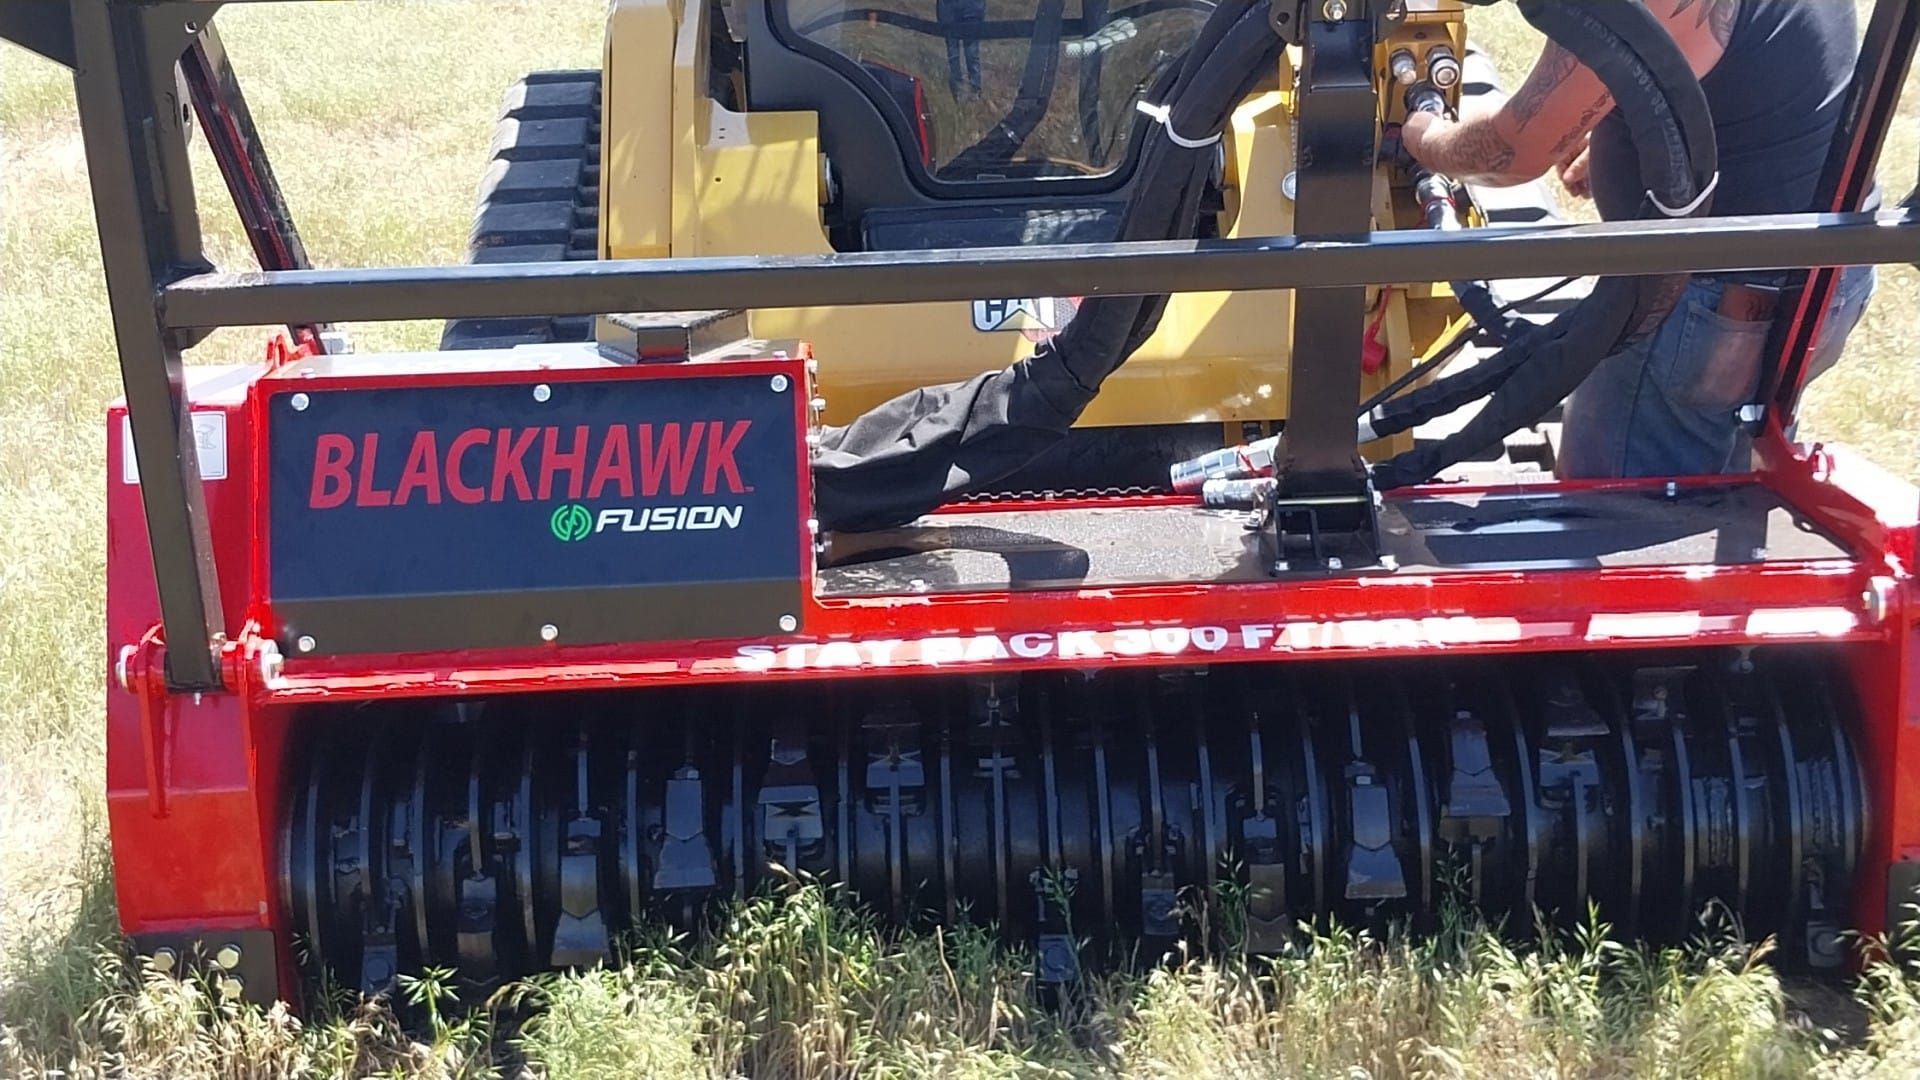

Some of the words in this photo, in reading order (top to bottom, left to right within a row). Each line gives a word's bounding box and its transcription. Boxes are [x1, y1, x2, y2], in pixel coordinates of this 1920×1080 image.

[309, 419, 753, 509] BLACKHAWK
[596, 505, 743, 533] FUSION
[734, 639, 902, 671] STAY
[921, 631, 1104, 662] BACK
[1112, 627, 1229, 656] 300
